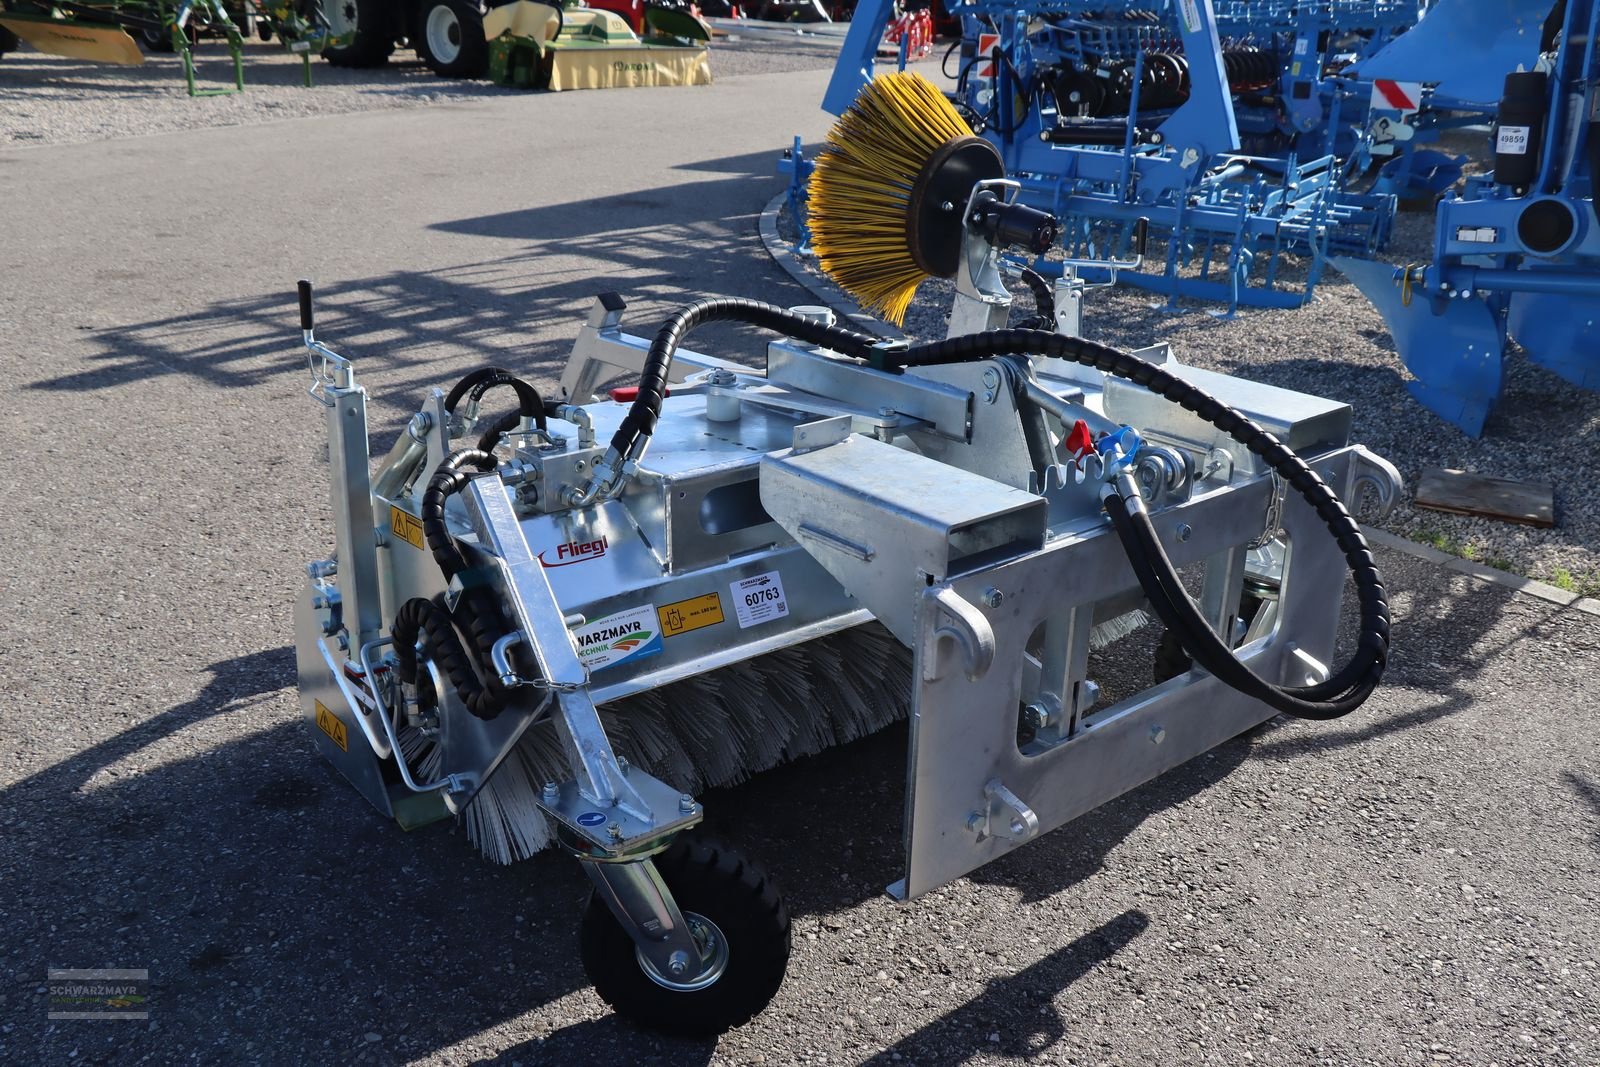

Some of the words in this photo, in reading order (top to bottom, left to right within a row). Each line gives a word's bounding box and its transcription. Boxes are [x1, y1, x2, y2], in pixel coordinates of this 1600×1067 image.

[1501, 135, 1525, 144] 49859
[557, 535, 608, 560] Fliegl
[745, 586, 780, 607] 60763
